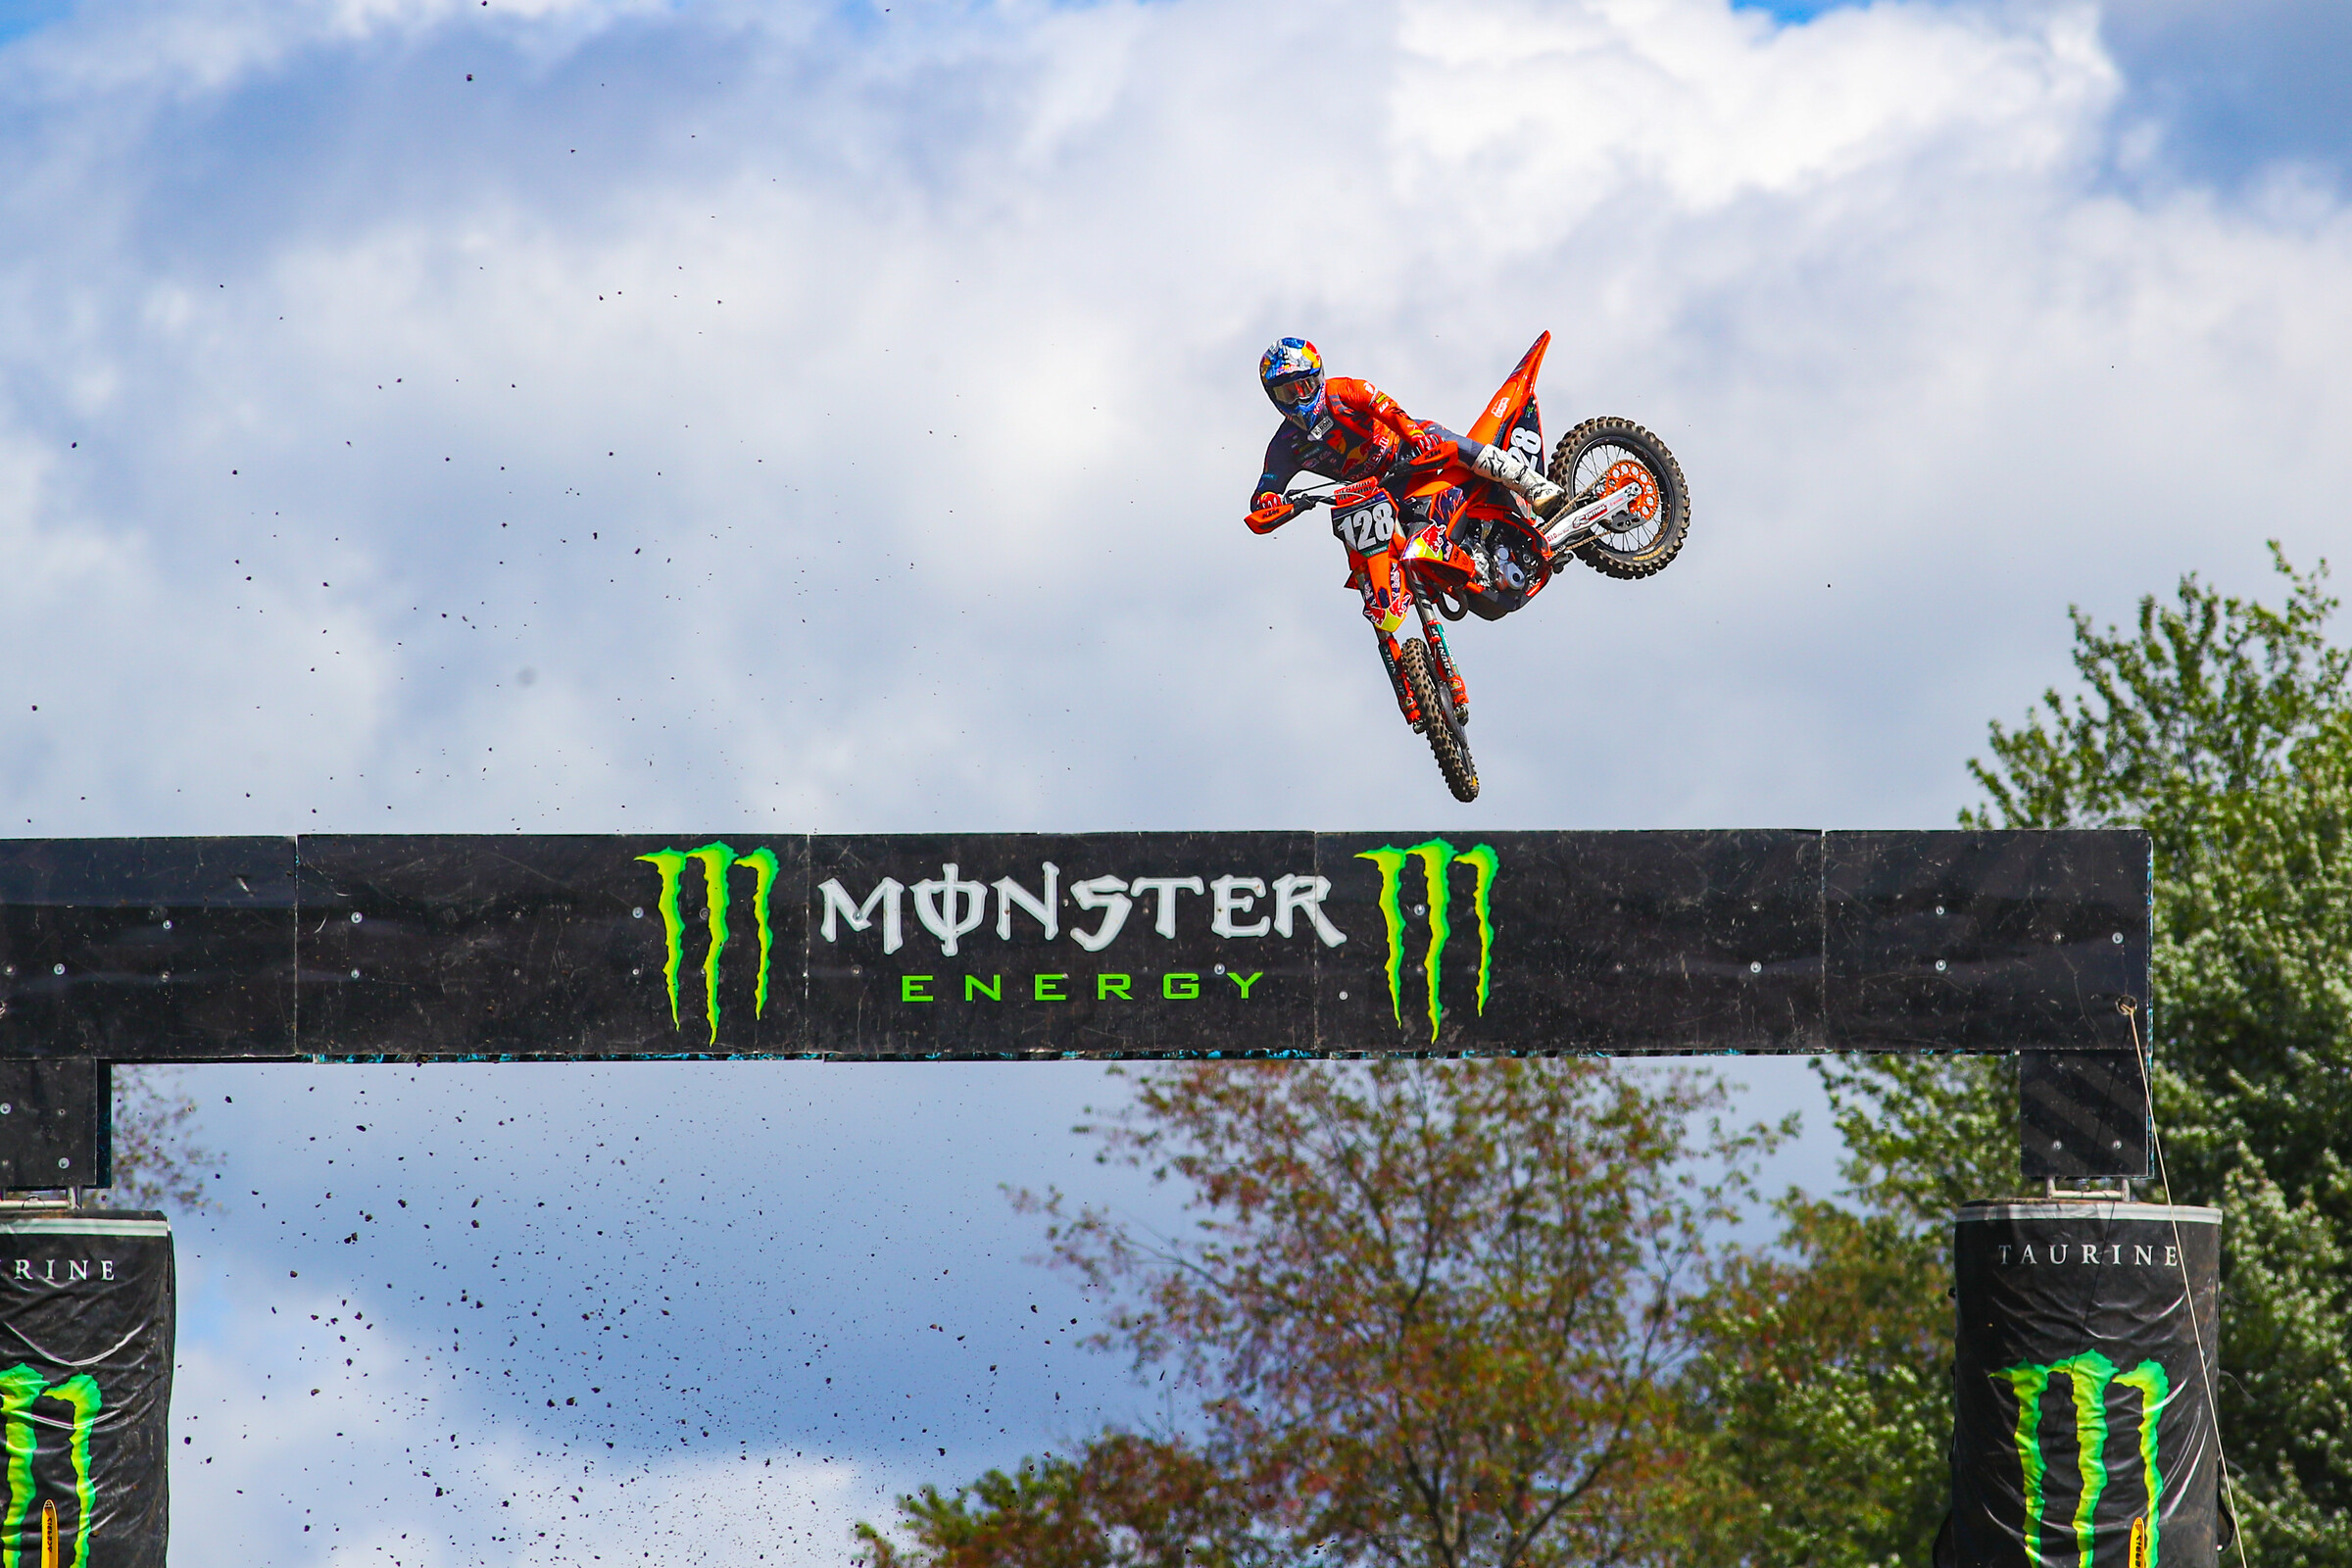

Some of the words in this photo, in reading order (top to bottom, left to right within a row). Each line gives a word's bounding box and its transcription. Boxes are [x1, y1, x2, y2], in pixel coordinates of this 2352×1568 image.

[1368, 436, 1390, 465] Bull
[1337, 503, 1395, 551] 128
[819, 862, 1348, 956] MONSTER
[902, 972, 1263, 1002] ENERGY
[0, 1258, 115, 1281] RINE
[1998, 1244, 2178, 1266] TAURINE
